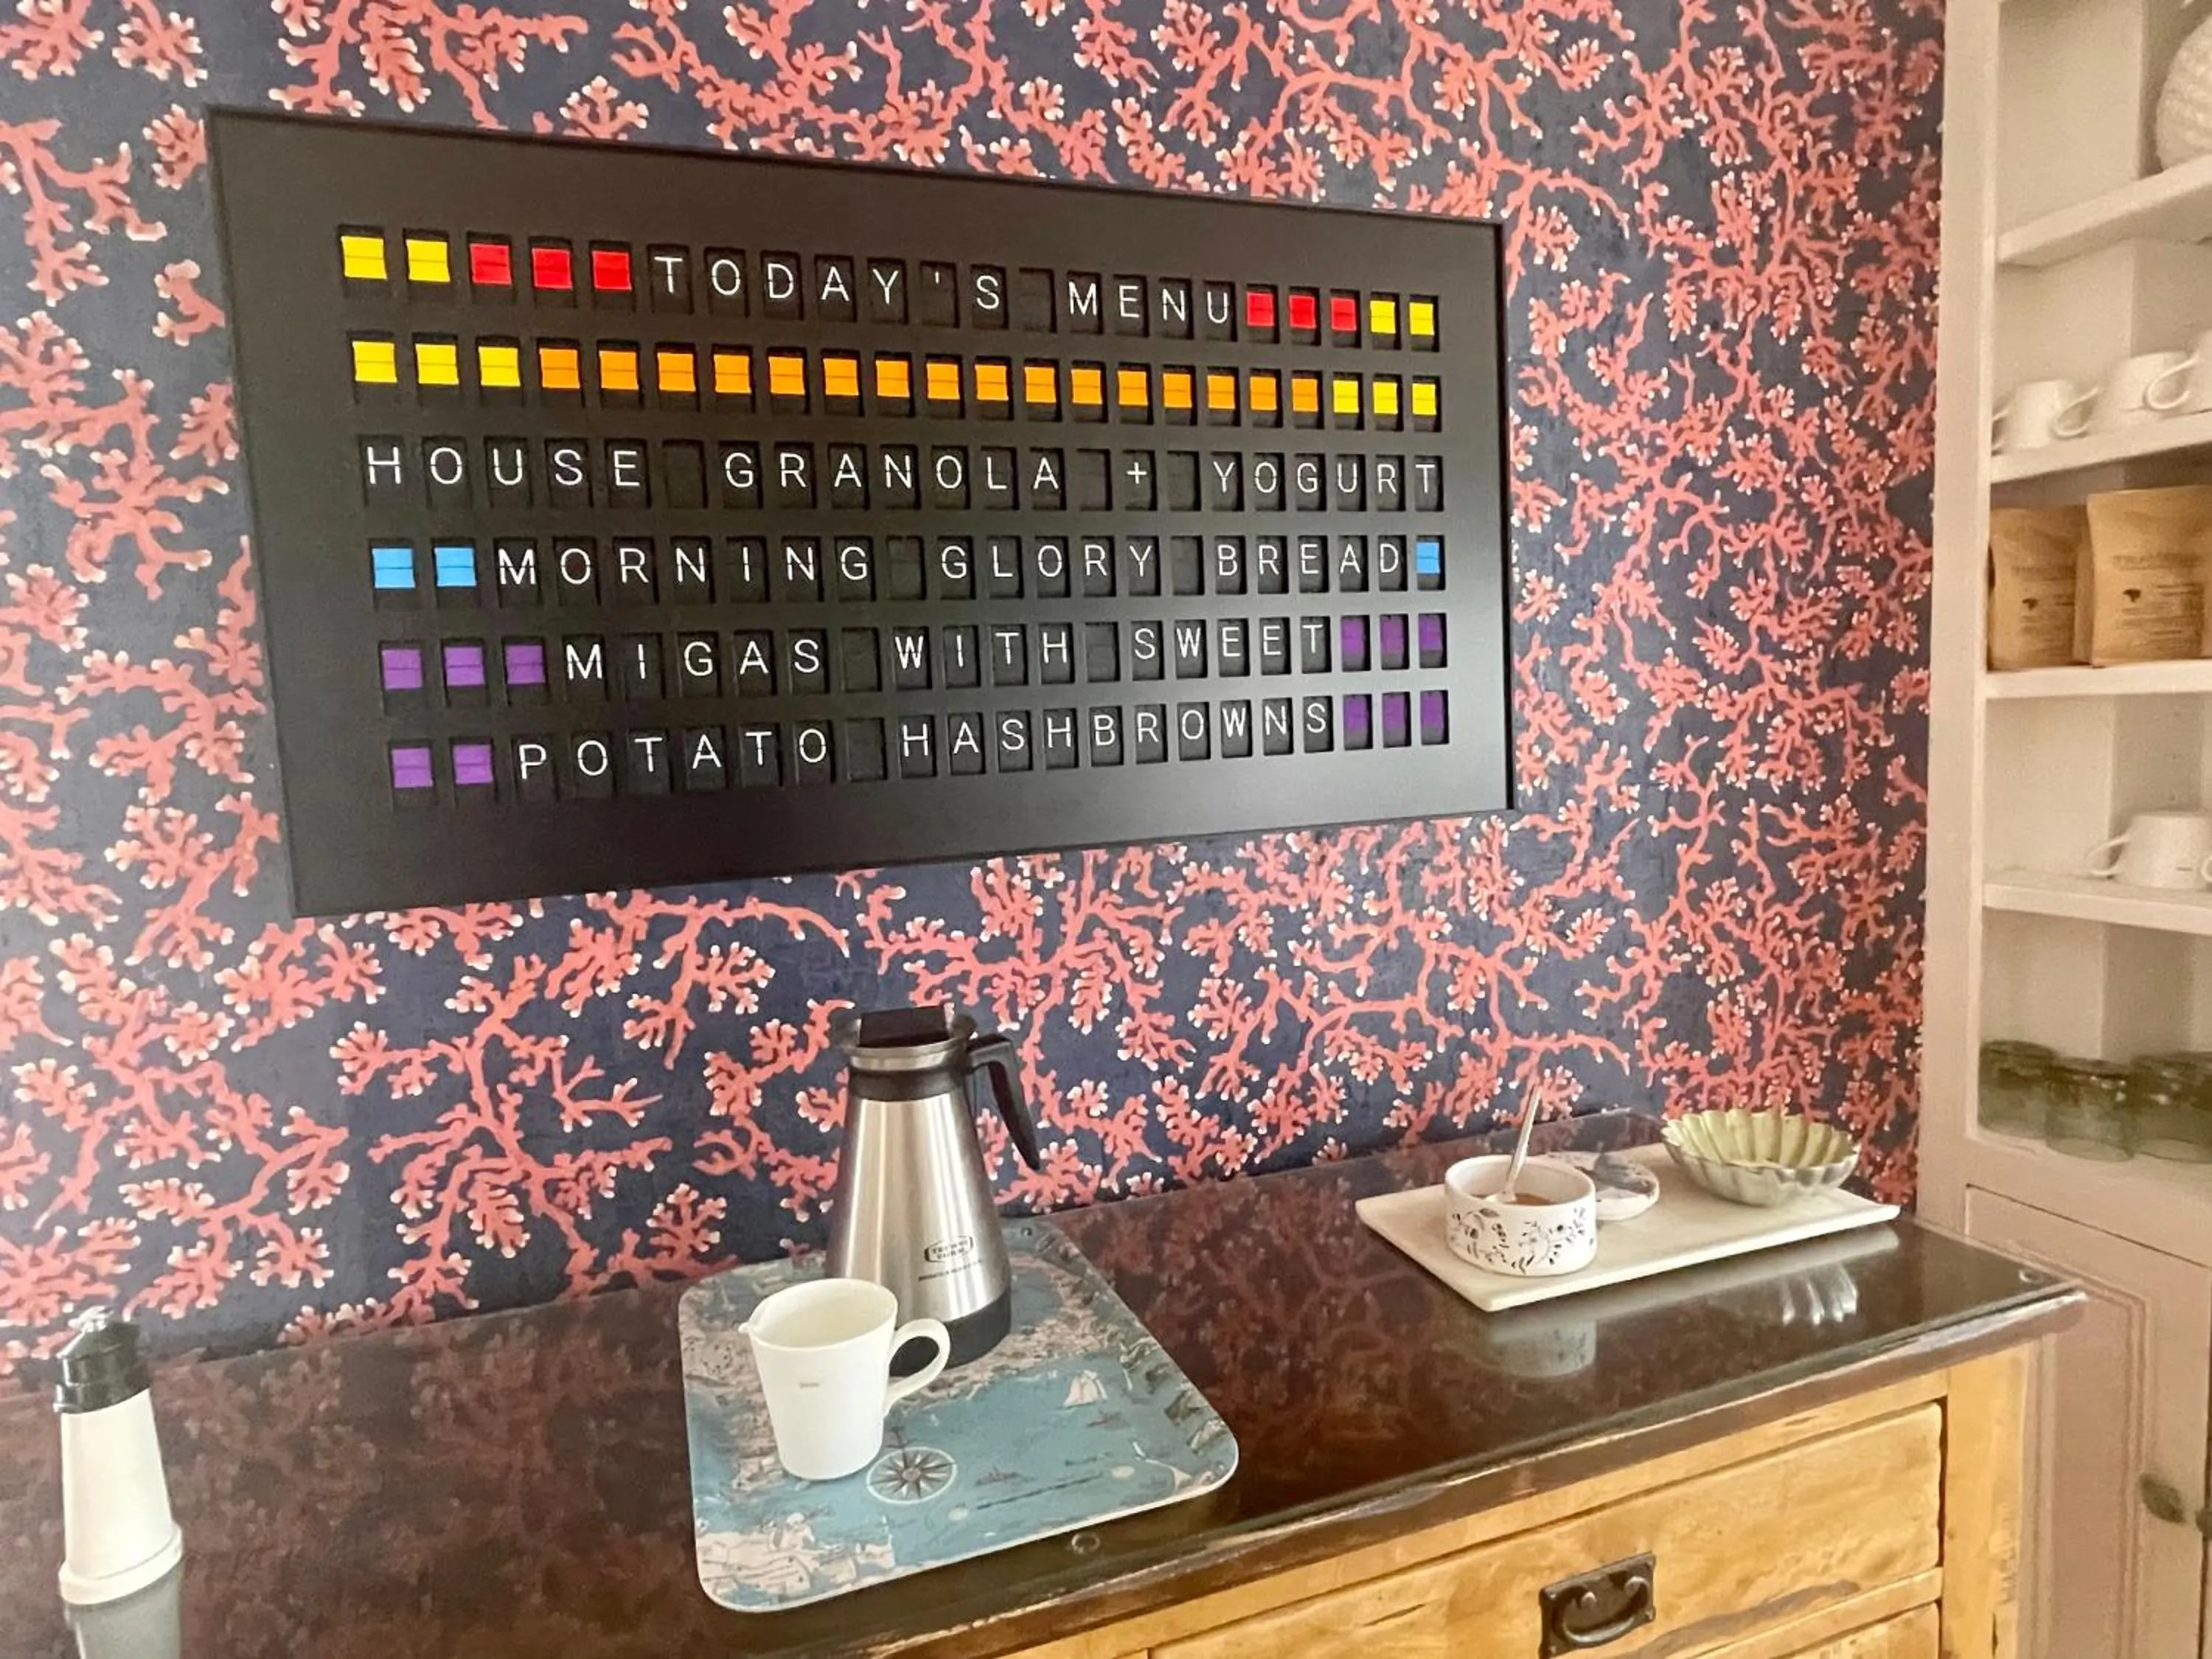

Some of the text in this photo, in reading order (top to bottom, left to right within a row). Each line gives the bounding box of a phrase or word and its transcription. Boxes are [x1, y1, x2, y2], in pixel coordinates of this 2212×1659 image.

[654, 256, 1229, 324] TODAY'S MENU
[366, 446, 1436, 494] HOUSE GRANOLA + YOGURT
[498, 543, 1399, 585] MORNING GLORY BREAD
[566, 624, 1323, 680] MIGAS WITH SWEET
[518, 703, 1326, 780] POTATO HASHBROWNS
